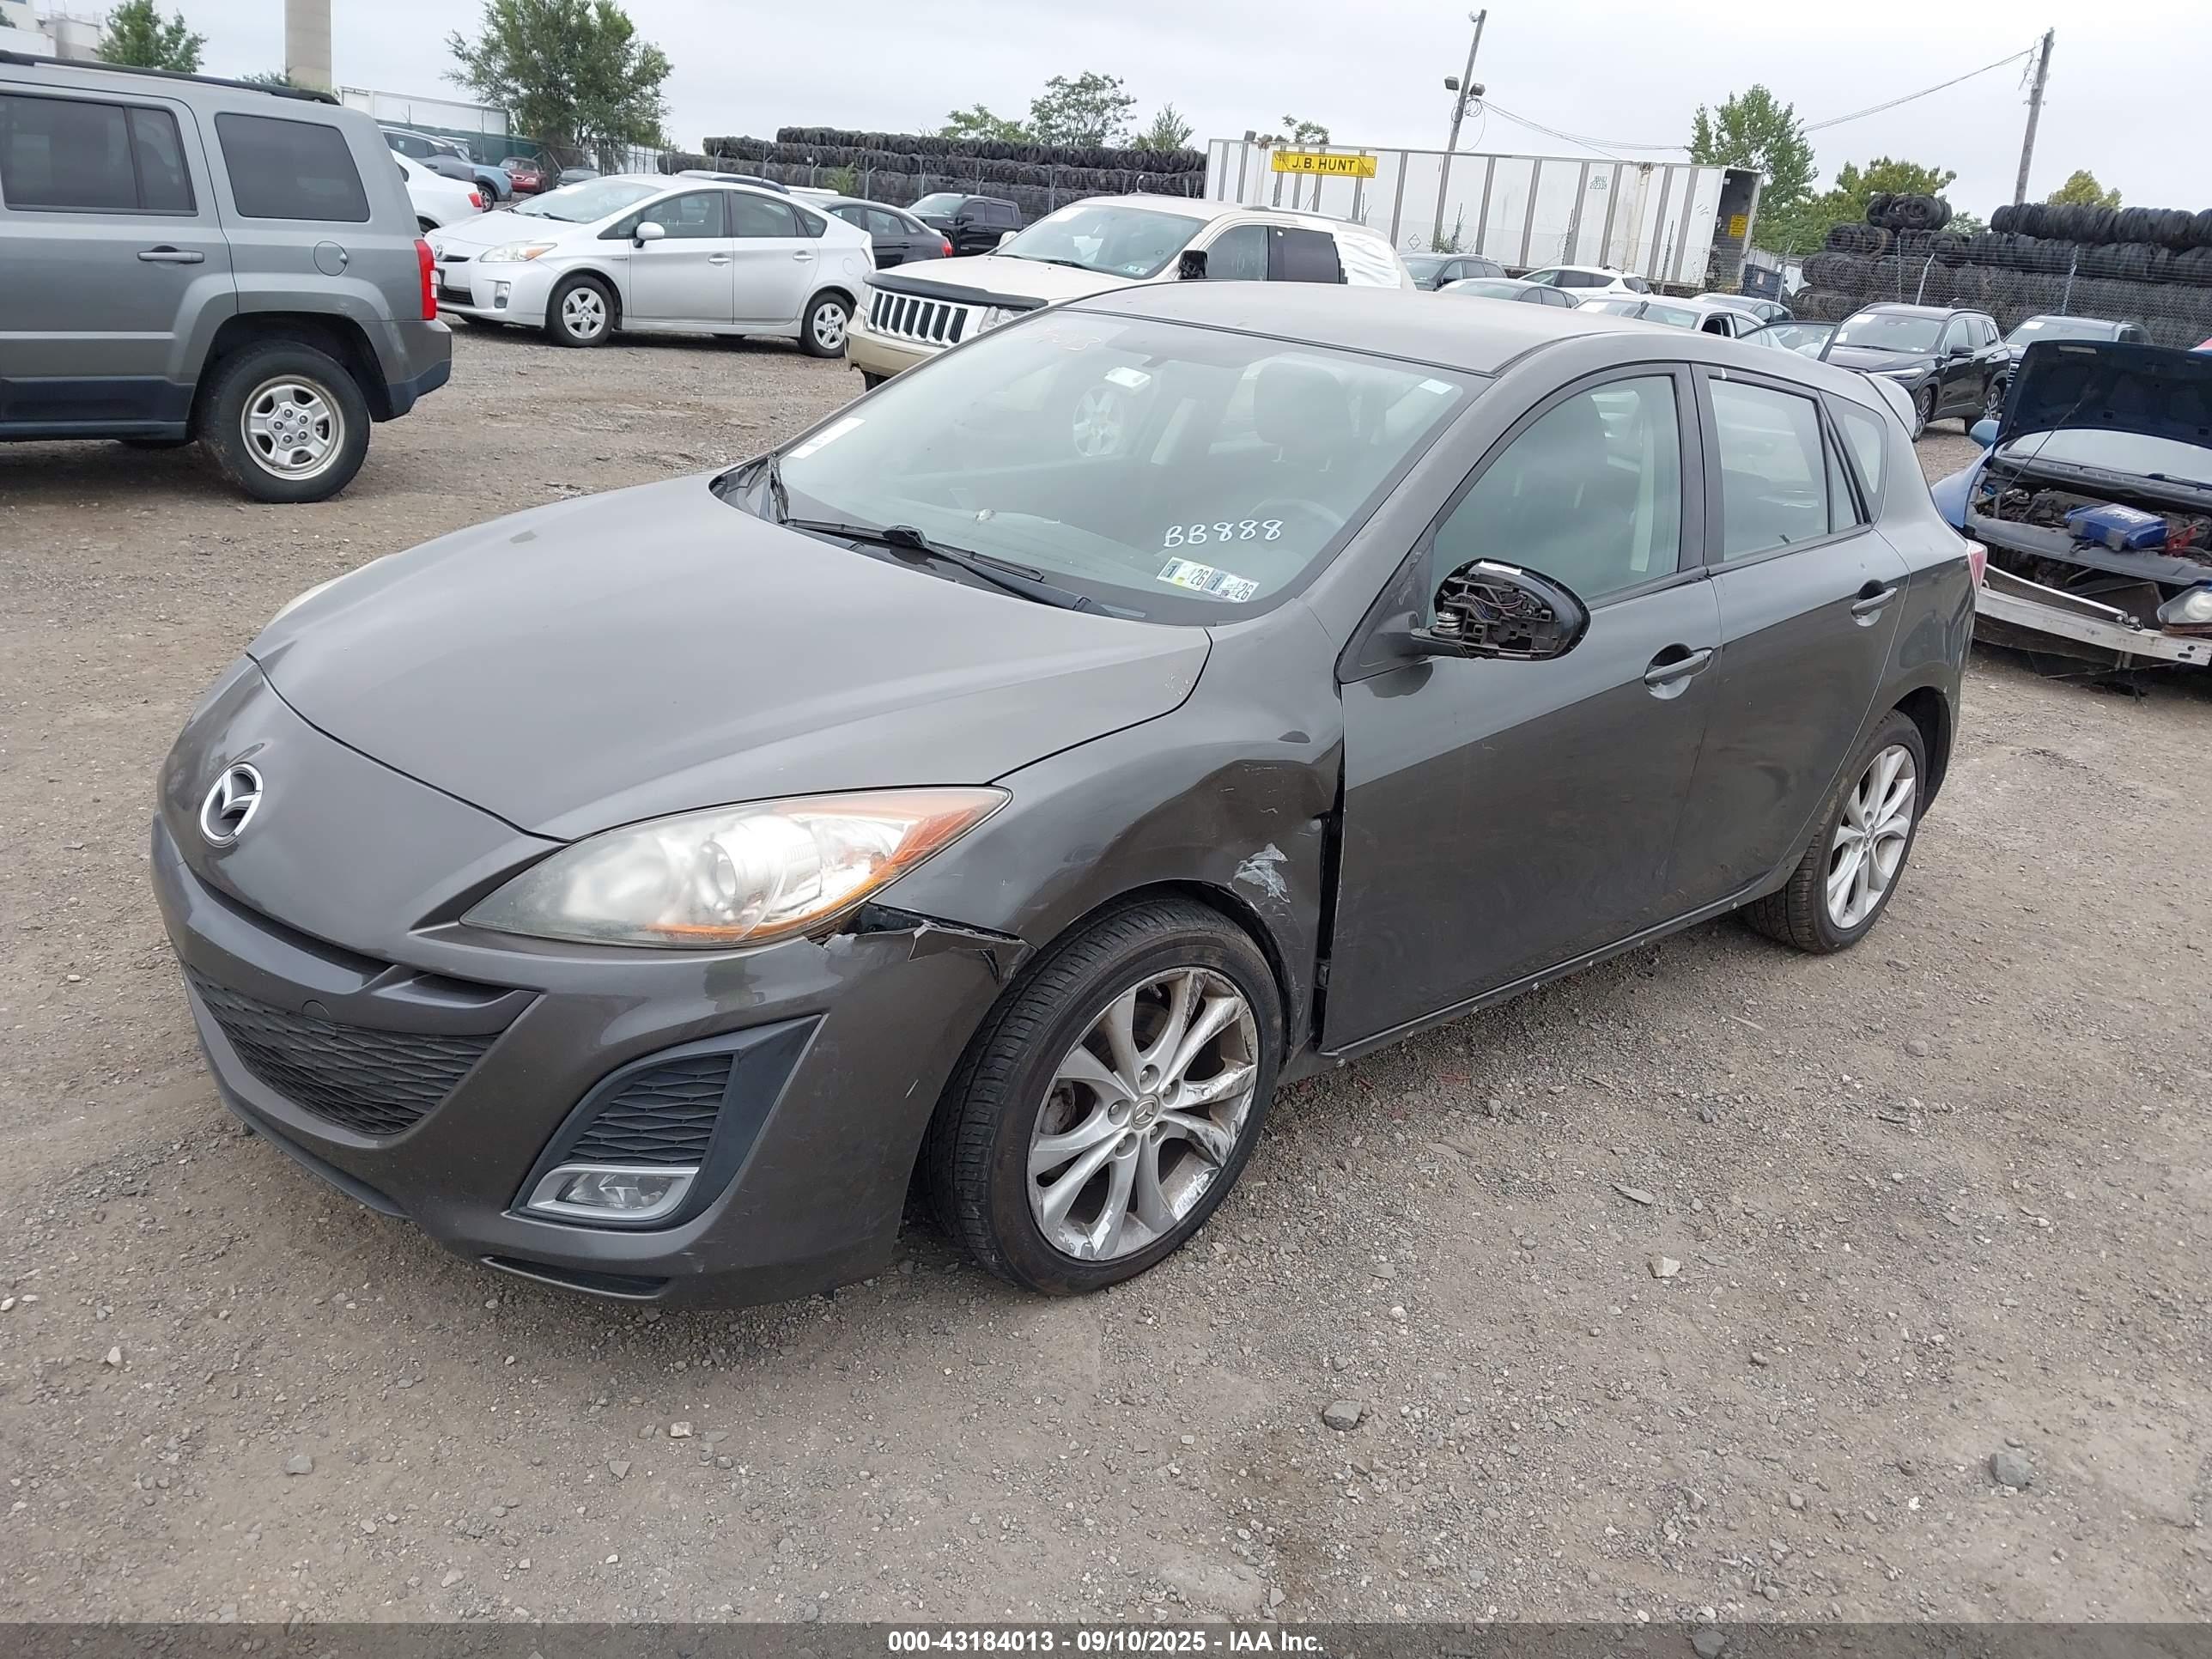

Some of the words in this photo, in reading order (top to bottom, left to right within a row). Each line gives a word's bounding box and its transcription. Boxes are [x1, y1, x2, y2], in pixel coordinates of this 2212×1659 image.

[1318, 158, 1356, 171] HUNT
[1163, 520, 1284, 547] BB888
[1190, 568, 1210, 586] 26
[1235, 582, 1254, 600] 26
